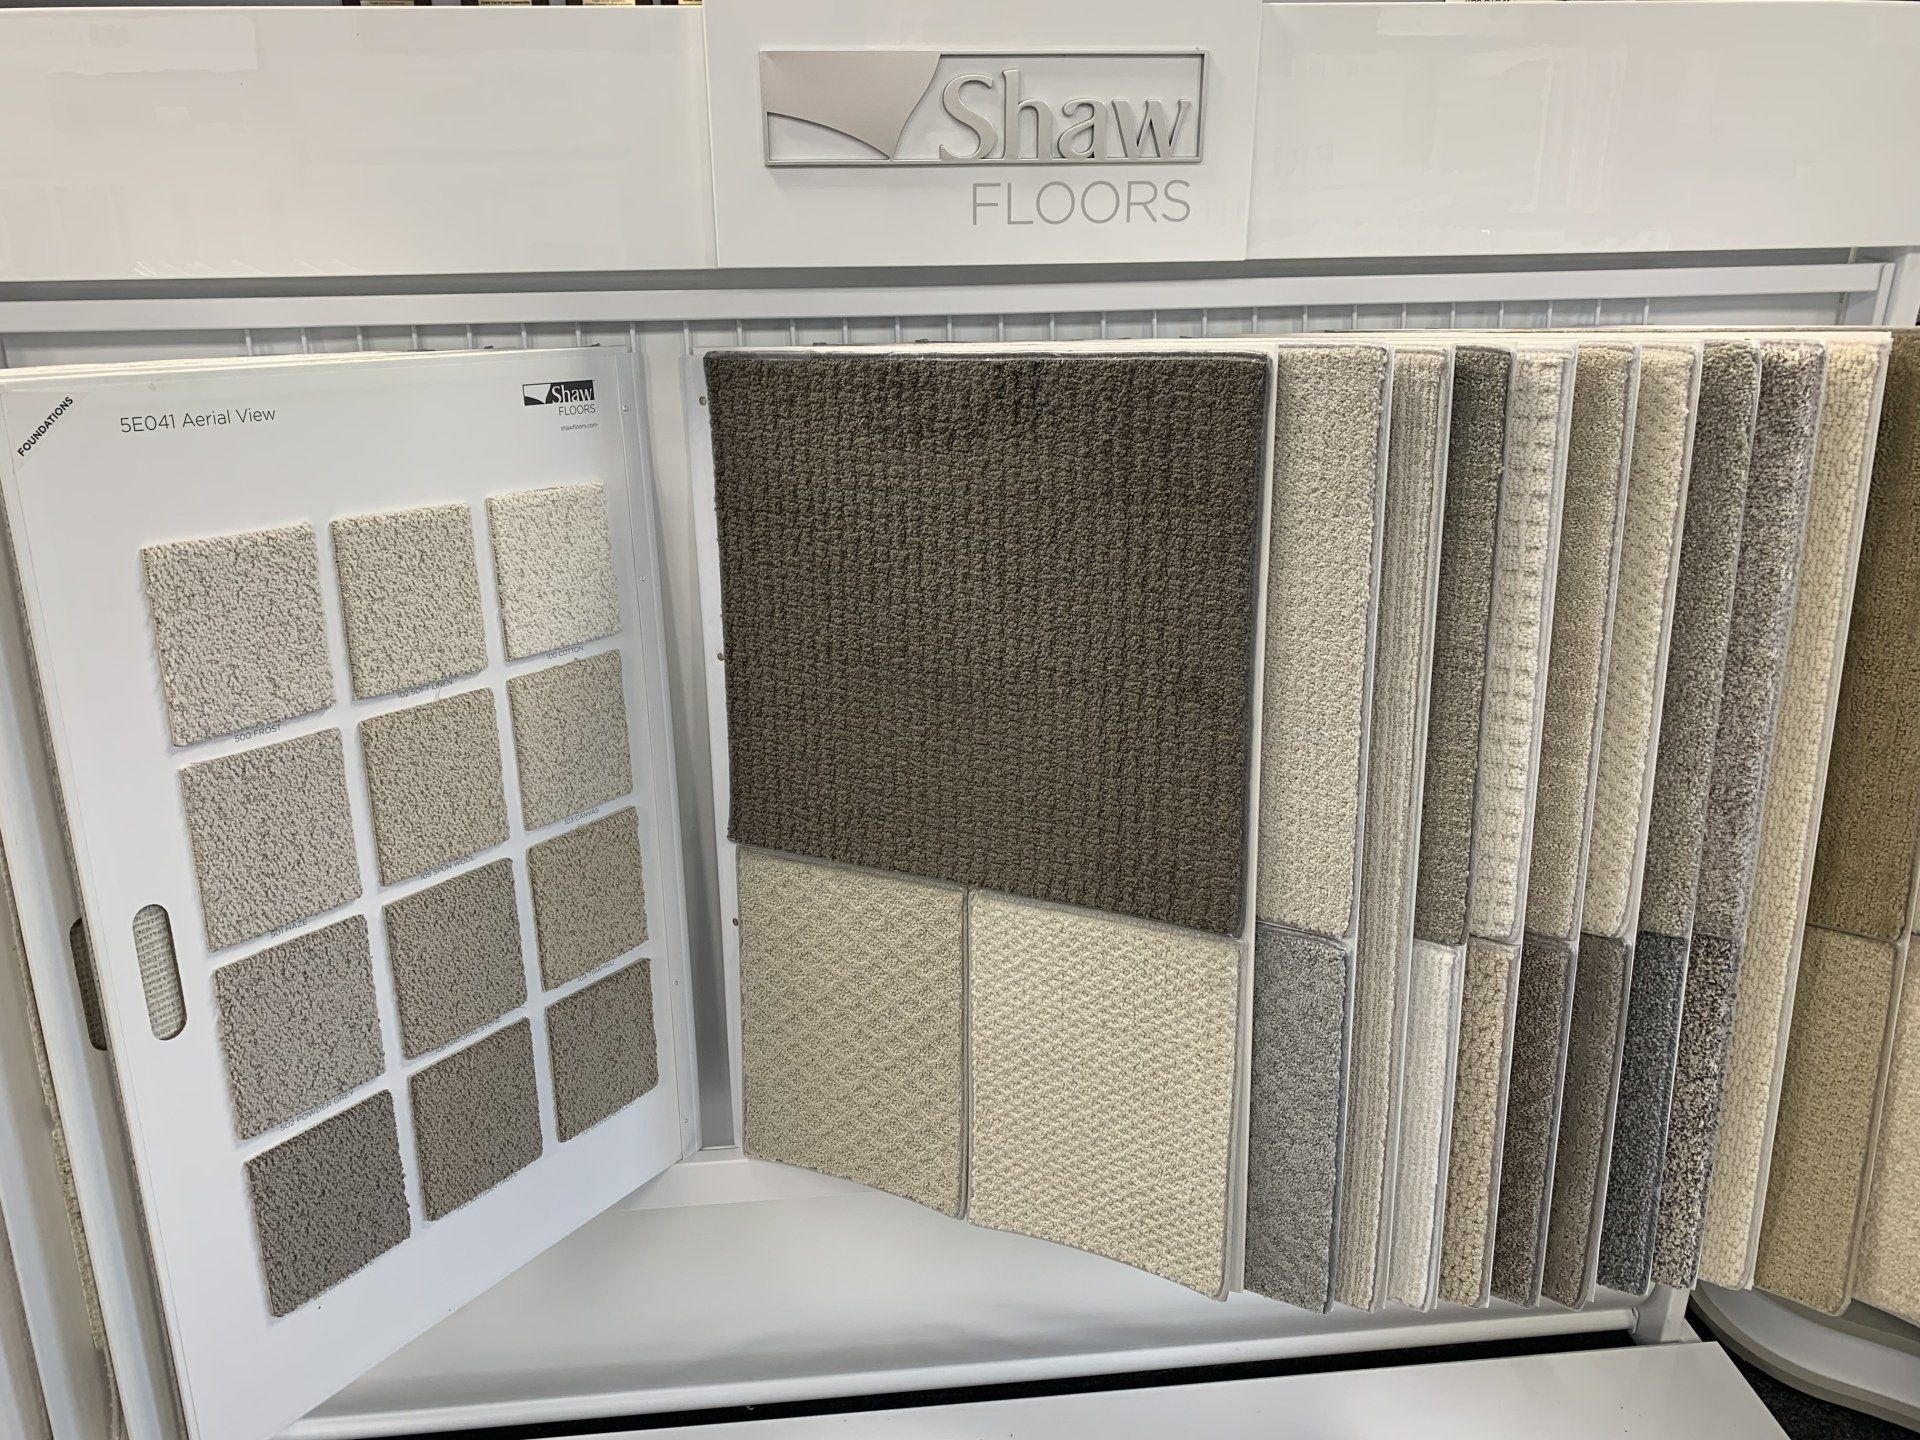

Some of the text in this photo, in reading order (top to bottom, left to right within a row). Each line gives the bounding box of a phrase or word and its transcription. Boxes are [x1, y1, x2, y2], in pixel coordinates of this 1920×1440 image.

[939, 68, 1191, 159] Shaw
[972, 179, 1191, 226] FLOORS
[551, 384, 592, 403] Shaw
[558, 404, 596, 416] FLOORS
[17, 396, 74, 457] FOUNDATIONS
[120, 408, 276, 433] 5E041 Aerial View
[560, 423, 598, 431] shawfloors.com
[558, 645, 584, 657] COTTON
[235, 723, 281, 742] 500 FROST
[285, 918, 307, 931] HAZE
[280, 1088, 354, 1131] 502 POWDER GREY
